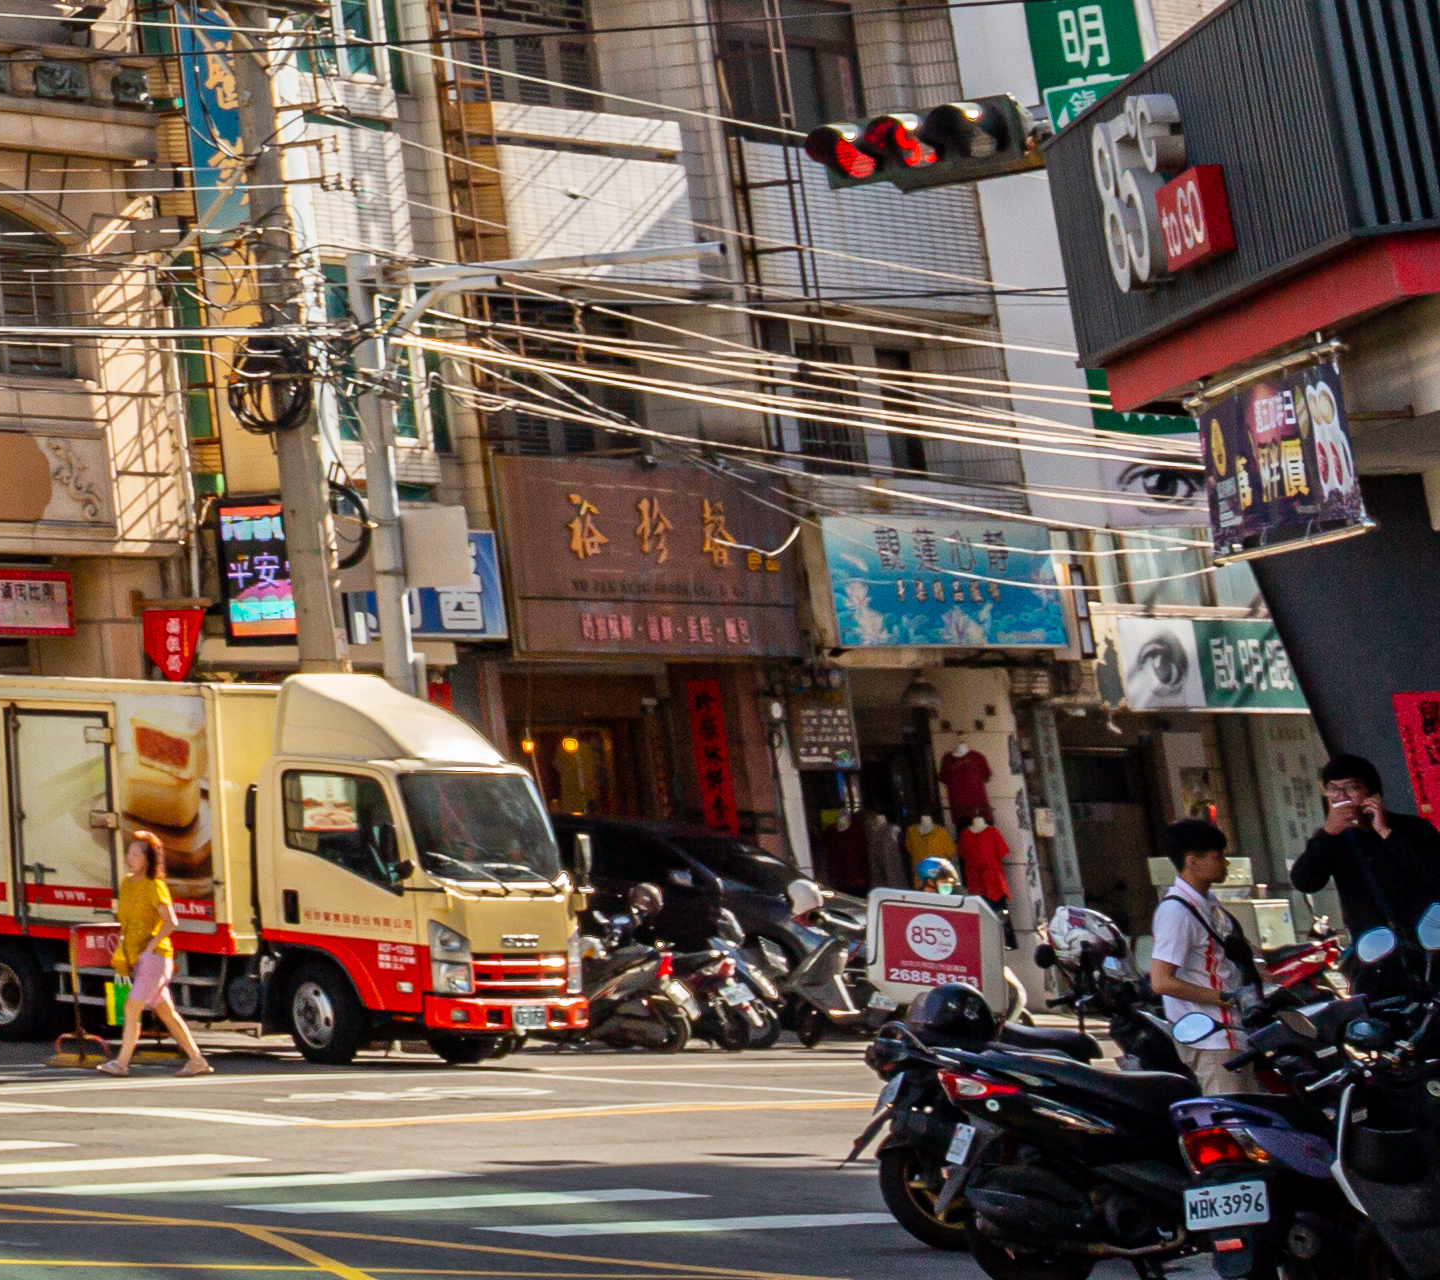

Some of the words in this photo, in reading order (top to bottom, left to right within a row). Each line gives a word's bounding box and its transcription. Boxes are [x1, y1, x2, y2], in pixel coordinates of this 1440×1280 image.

[566, 493, 738, 570] 裕珍馨
[227, 551, 291, 589] 平安
[1188, 1192, 1265, 1220] MBK-3996
